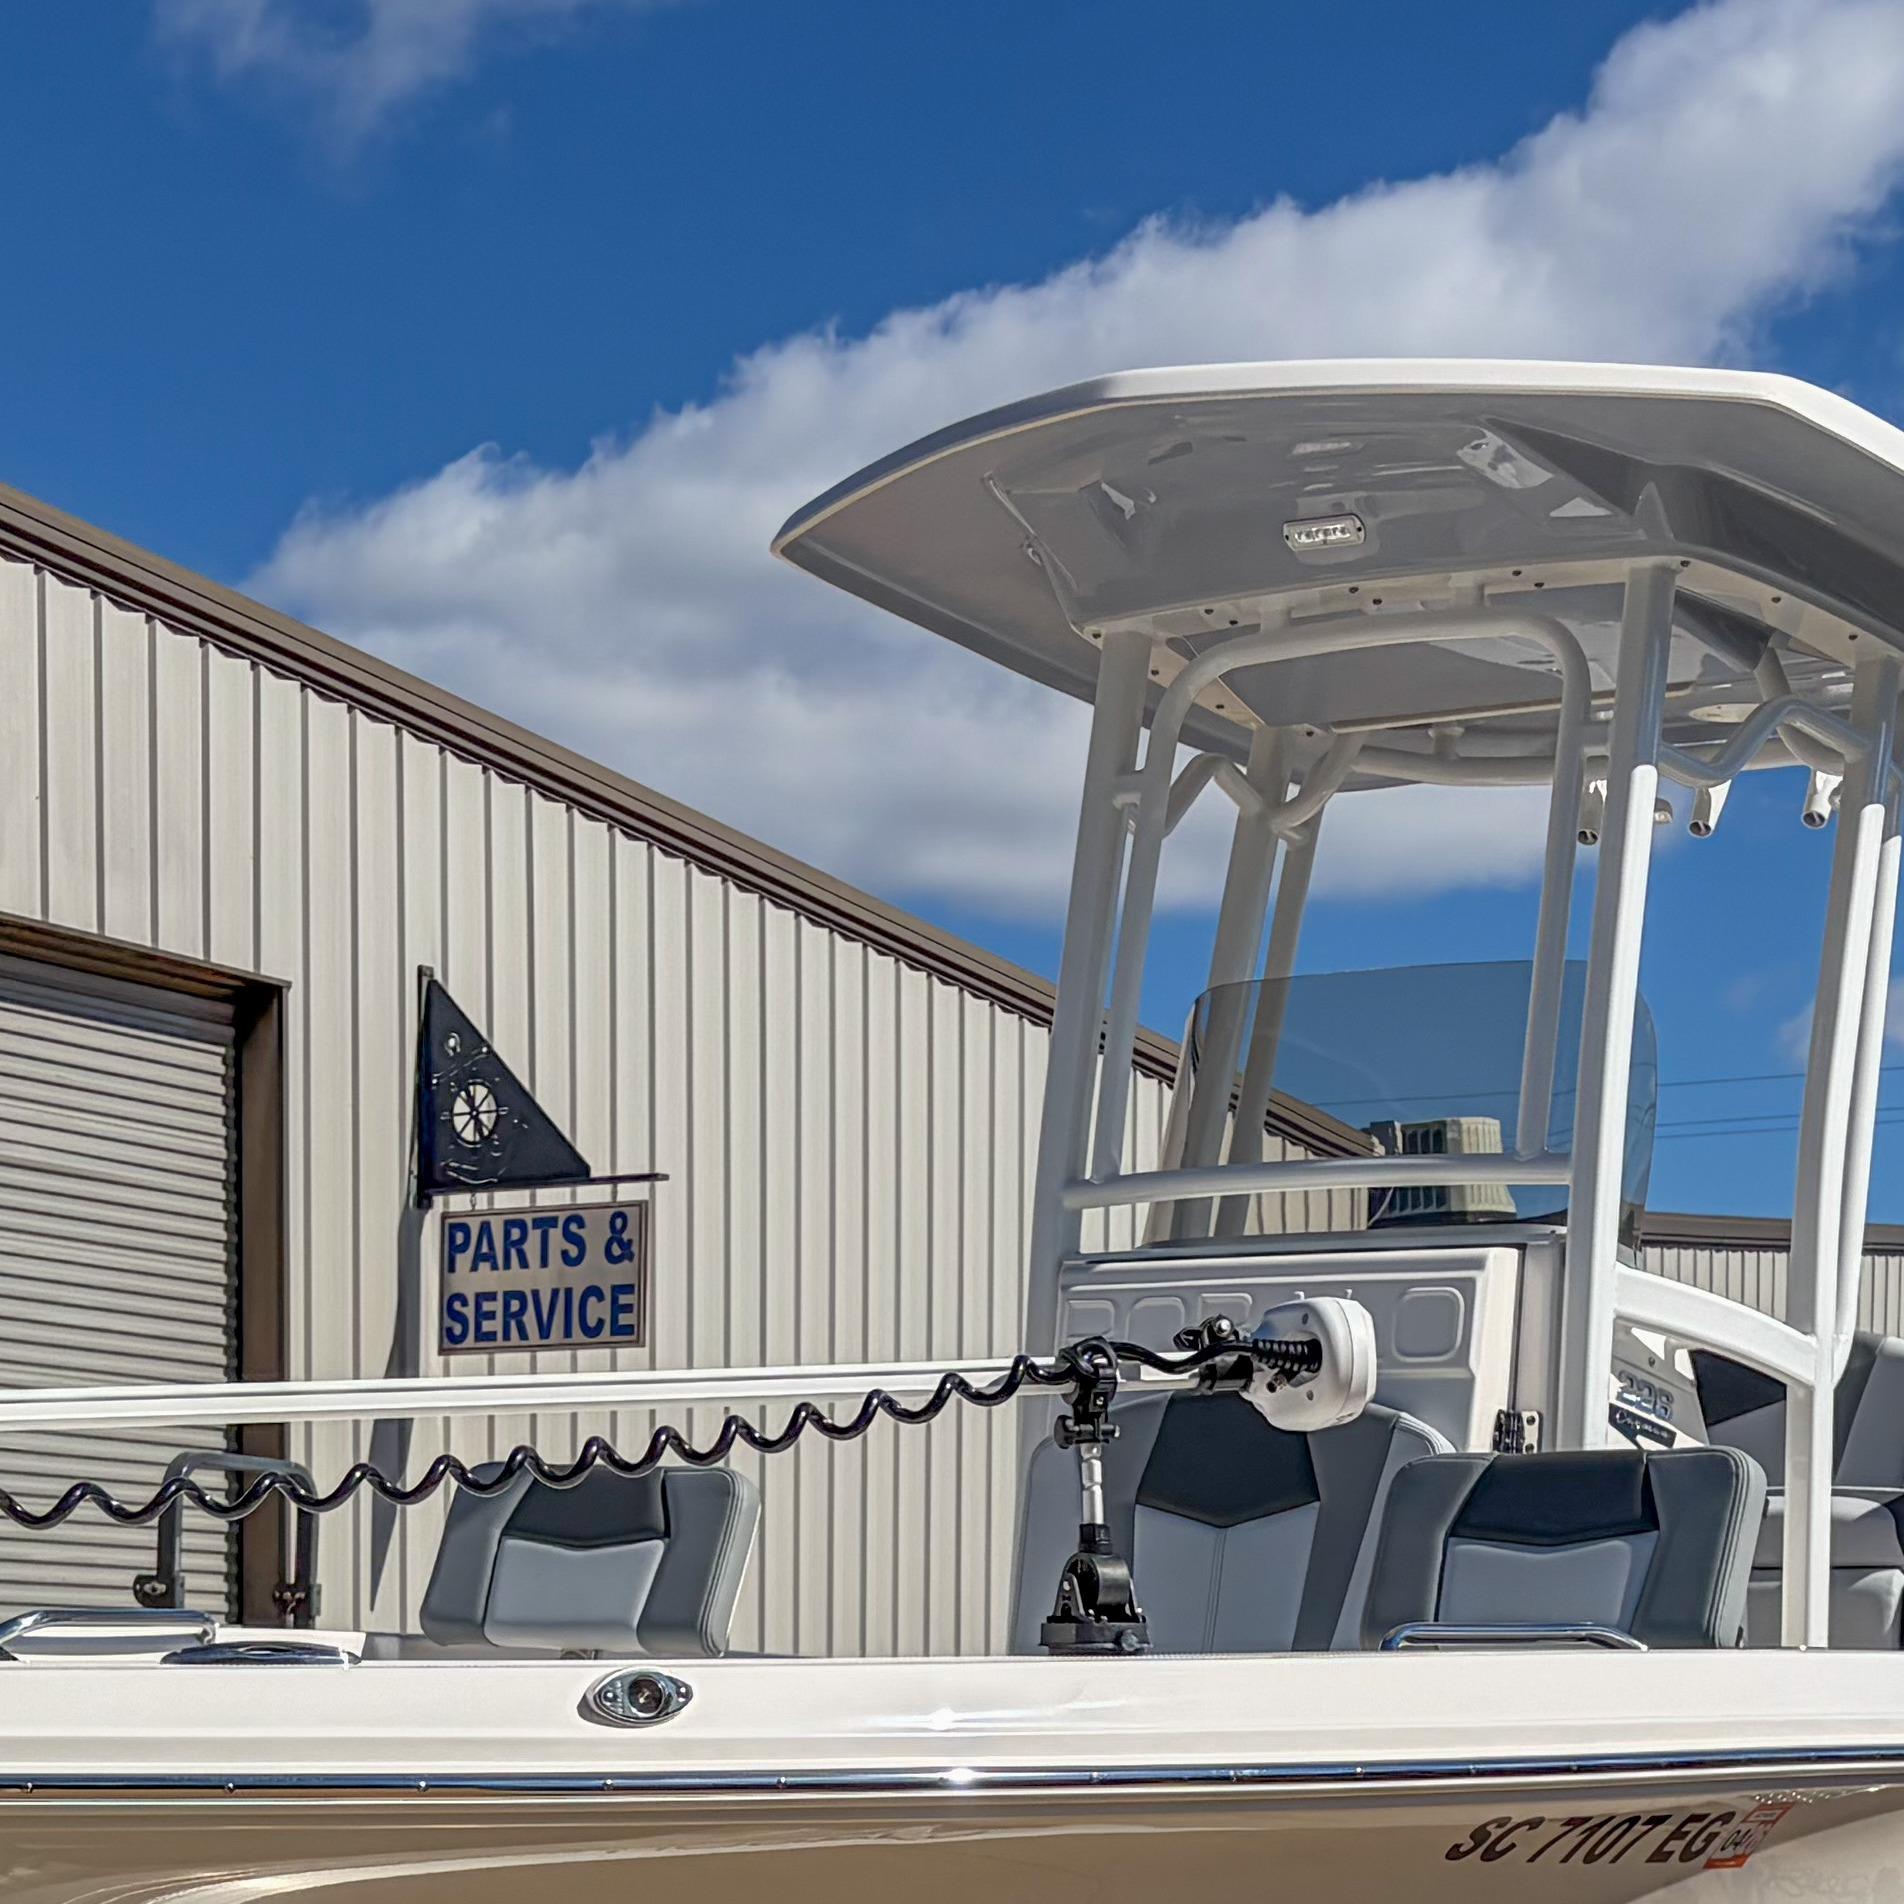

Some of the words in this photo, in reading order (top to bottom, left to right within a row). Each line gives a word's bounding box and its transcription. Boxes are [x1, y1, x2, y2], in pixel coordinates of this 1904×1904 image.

[447, 1213, 588, 1274] PARTS
[603, 1210, 636, 1265] &
[445, 1284, 636, 1346] SERVICE
[1445, 1815, 1546, 1863] SC
[1526, 1814, 1673, 1865] 7107
[1644, 1810, 1737, 1864] EG
